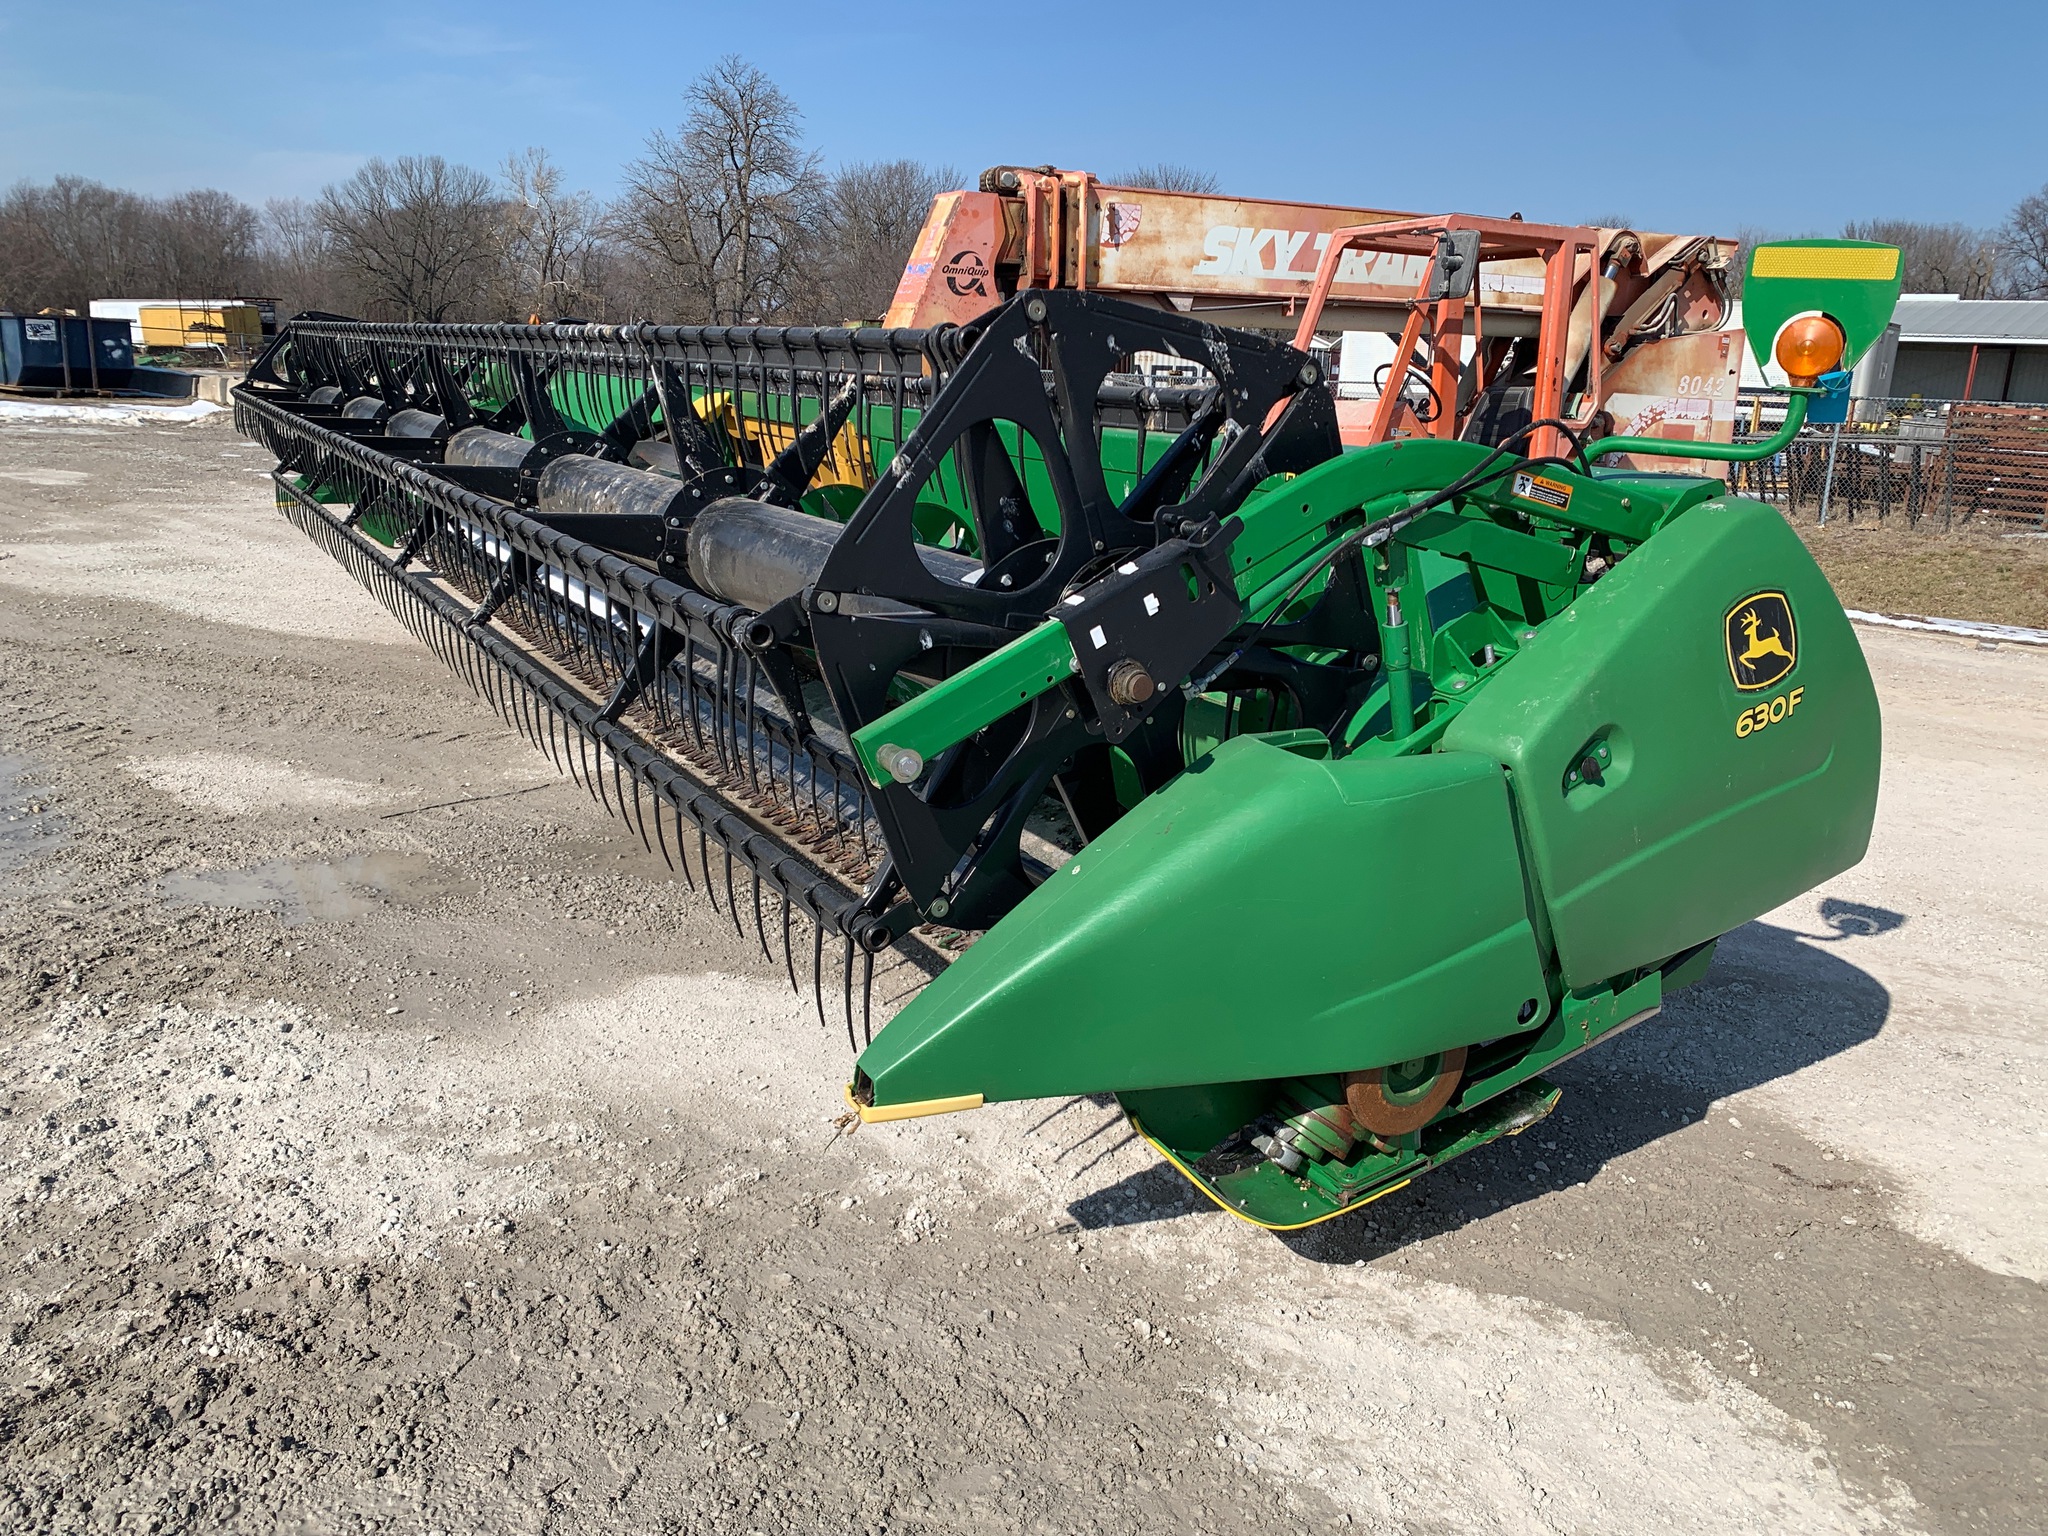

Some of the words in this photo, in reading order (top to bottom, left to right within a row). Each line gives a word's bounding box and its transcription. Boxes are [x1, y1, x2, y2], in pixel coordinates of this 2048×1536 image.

[942, 265, 989, 278] OmniQuip
[1677, 375, 1725, 397] 8042
[1545, 480, 1567, 491] WARNING
[1735, 685, 1806, 739] 630F
